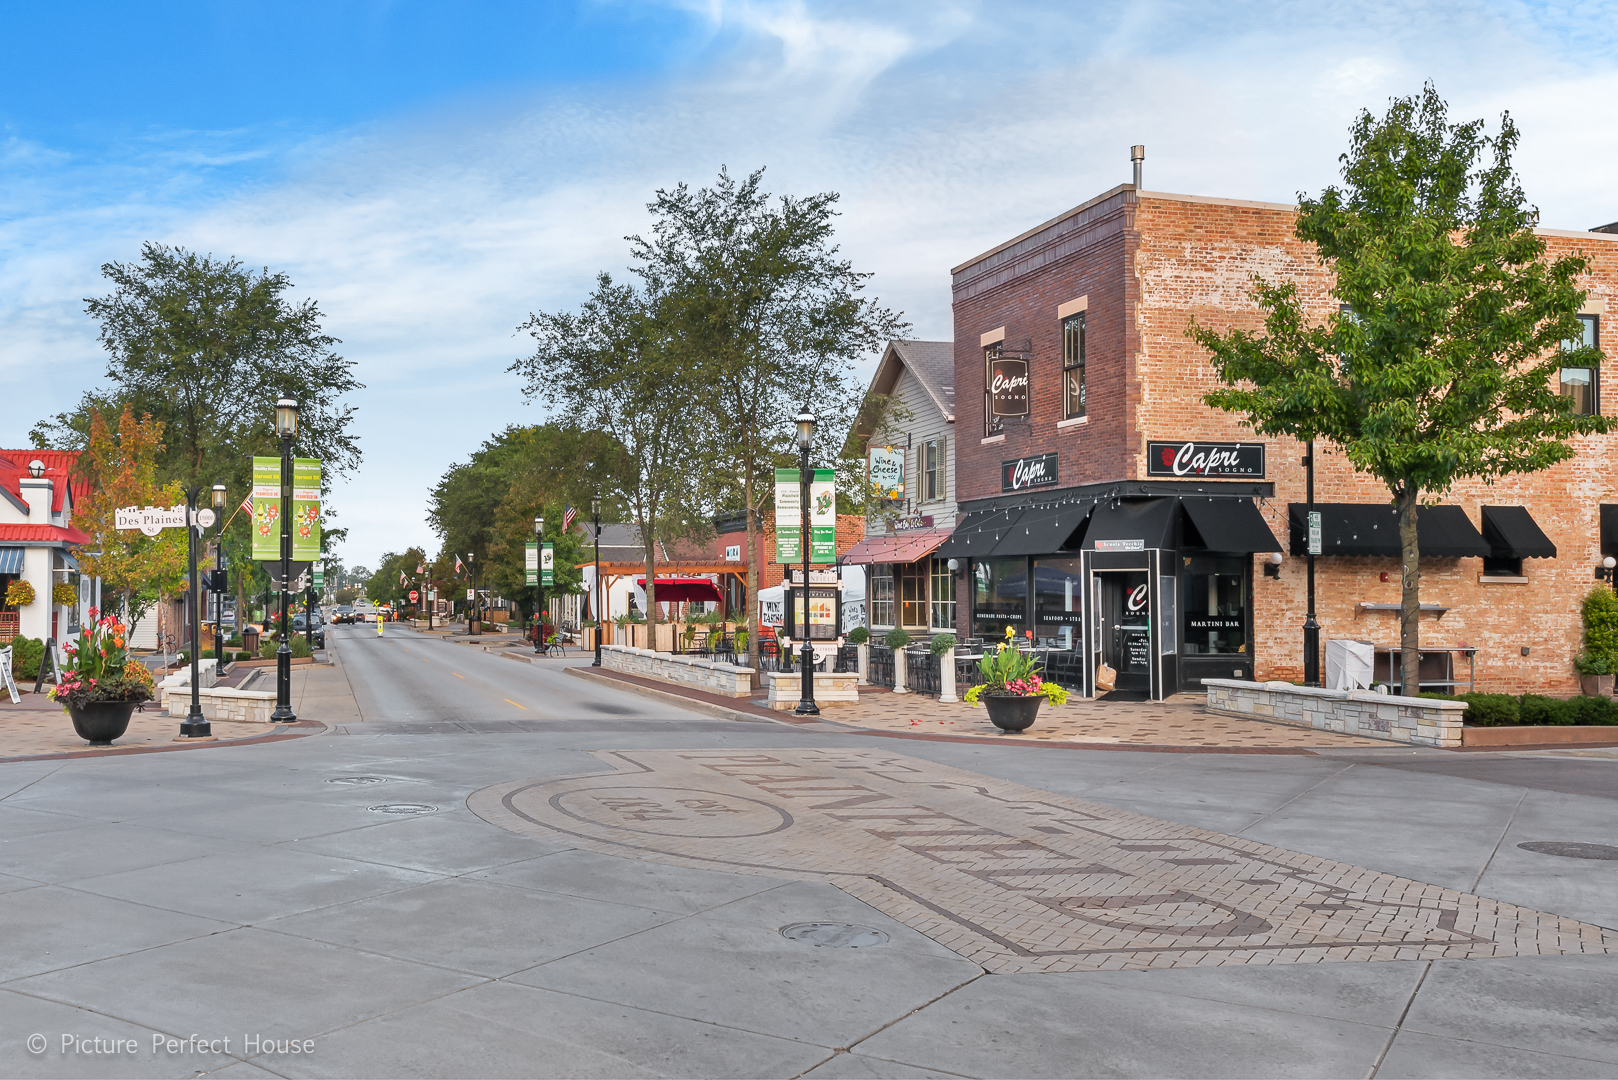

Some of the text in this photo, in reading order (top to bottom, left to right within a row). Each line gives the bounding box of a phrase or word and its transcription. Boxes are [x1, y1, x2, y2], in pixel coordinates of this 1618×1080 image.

[991, 372, 1028, 393] Capri
[874, 456, 892, 465] Wine
[1173, 442, 1240, 476] Capri
[872, 465, 898, 474] Cheese
[1012, 454, 1046, 490] Capri
[1034, 475, 1052, 483] SOGNO
[119, 514, 184, 526] Des Plaines
[591, 795, 688, 822] 1834
